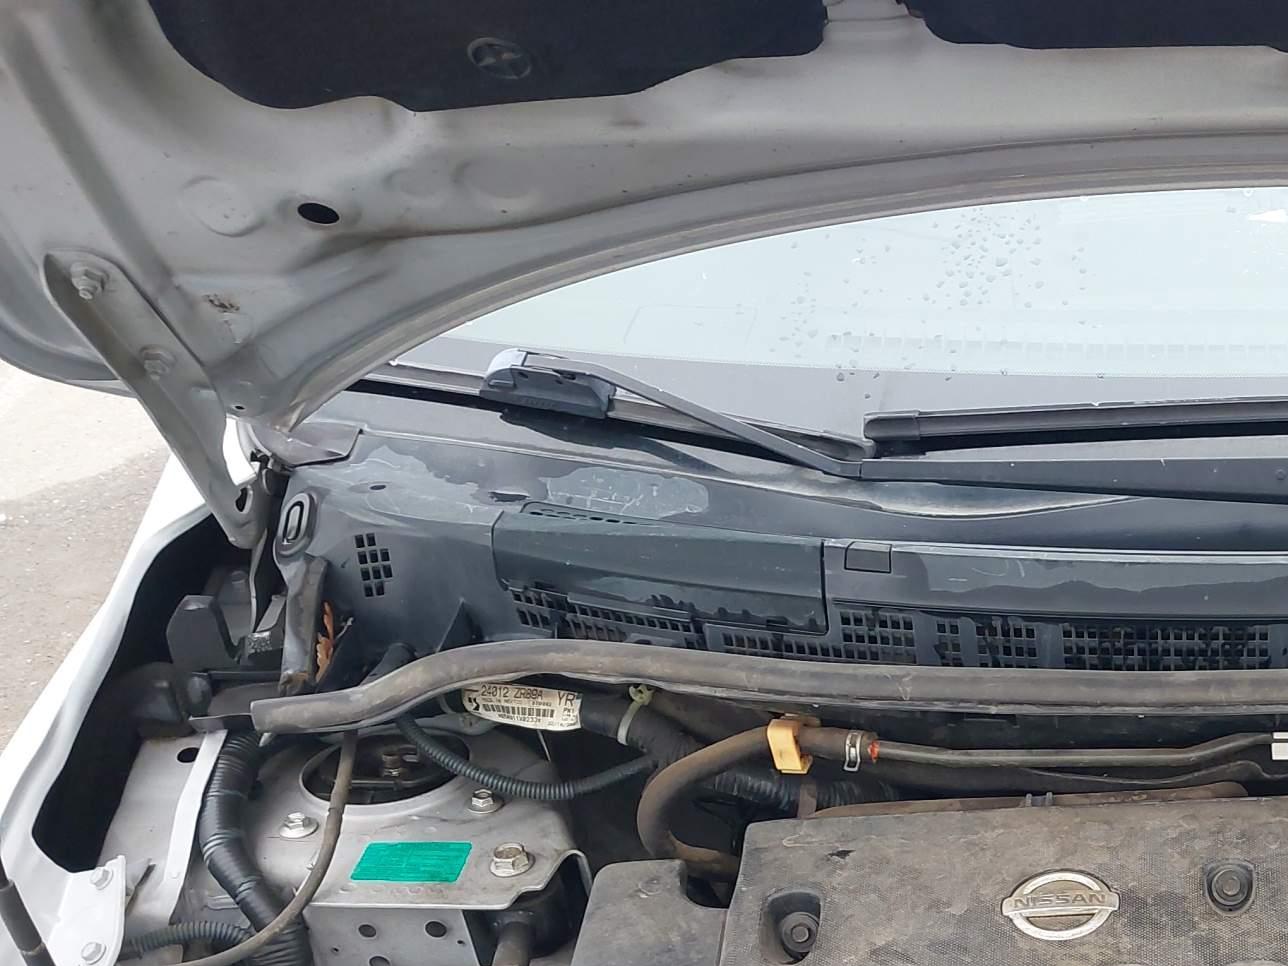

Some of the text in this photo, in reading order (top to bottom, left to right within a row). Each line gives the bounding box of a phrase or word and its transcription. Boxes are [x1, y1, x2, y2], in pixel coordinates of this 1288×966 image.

[481, 684, 510, 698] 24012
[557, 691, 576, 706] YR
[1013, 892, 1106, 908] NISSAN
